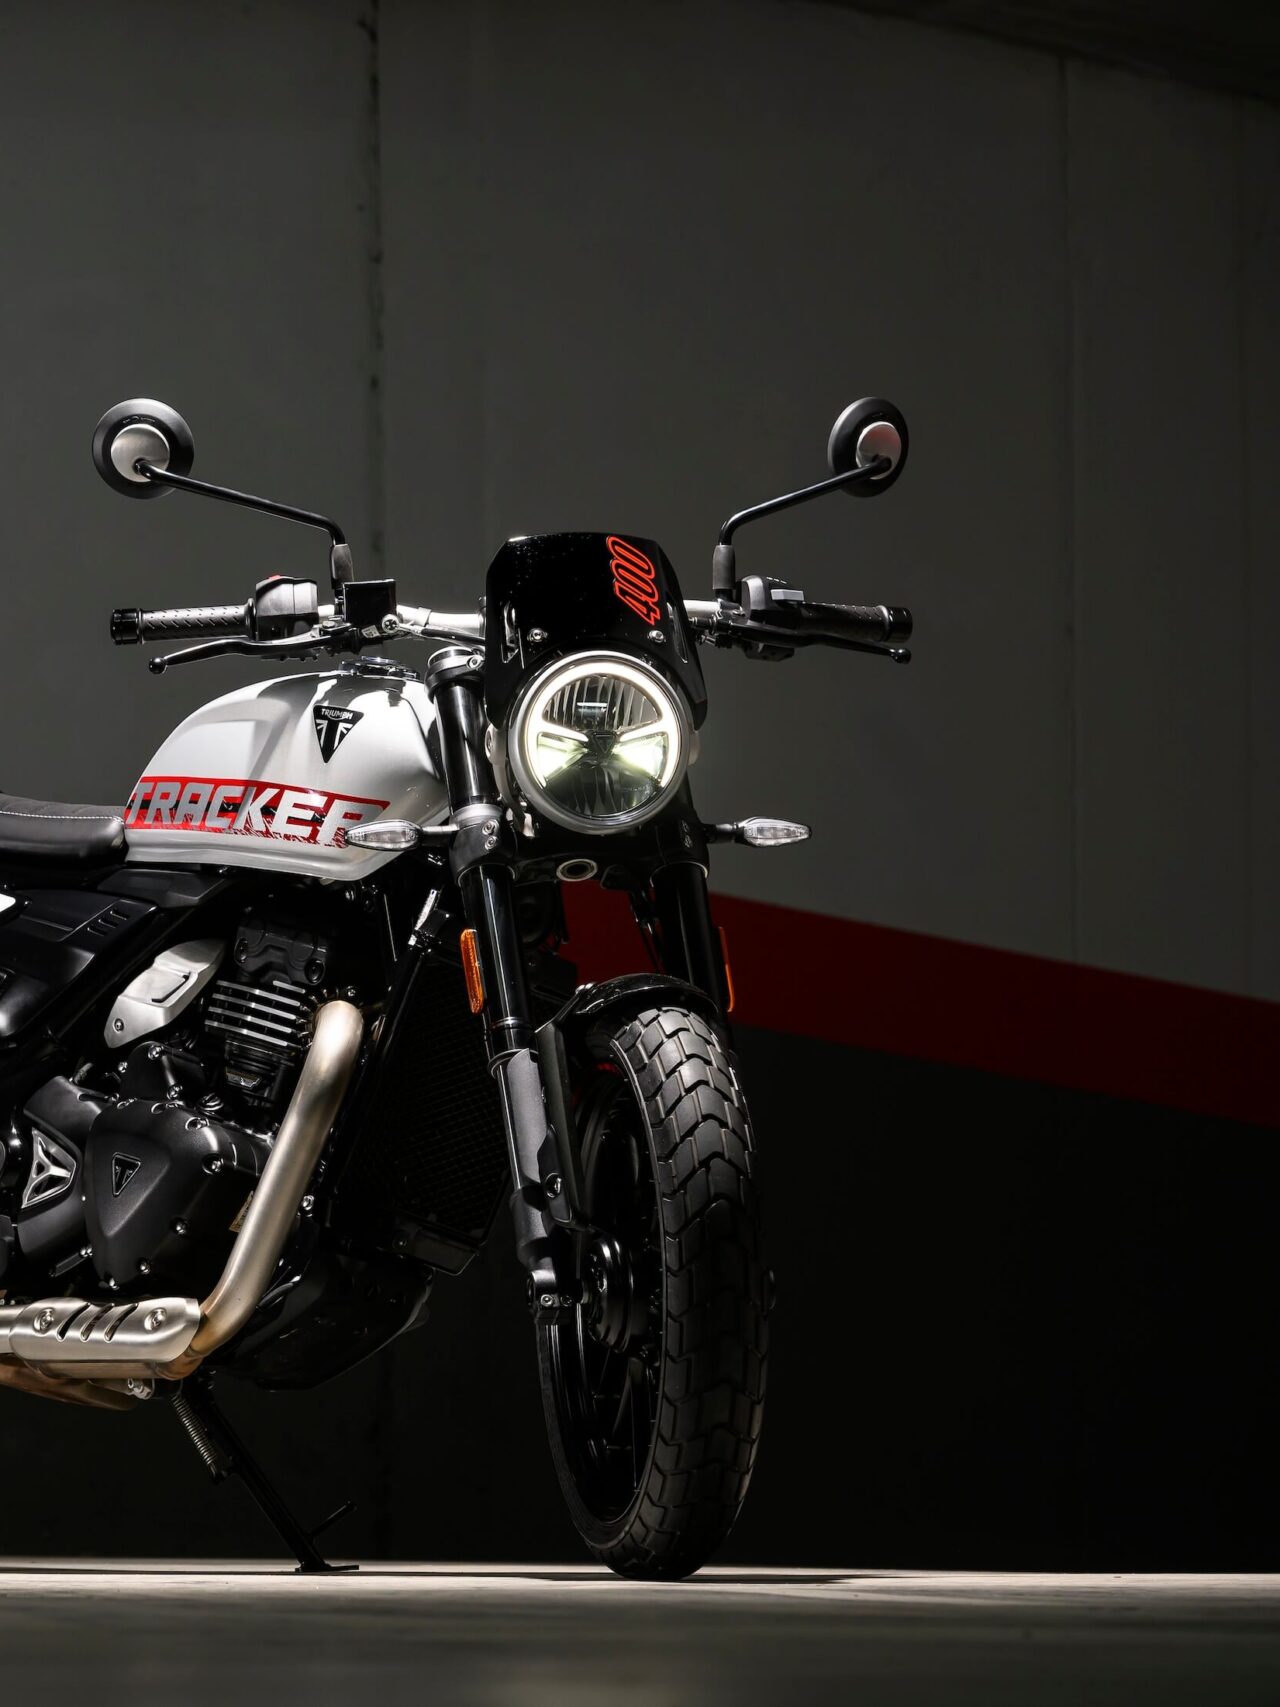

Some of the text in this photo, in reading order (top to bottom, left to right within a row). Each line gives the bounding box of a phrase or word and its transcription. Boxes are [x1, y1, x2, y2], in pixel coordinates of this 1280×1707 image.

[606, 535, 661, 626] 400
[321, 708, 354, 720] TRIUMPH
[124, 781, 387, 845] TRACKER
